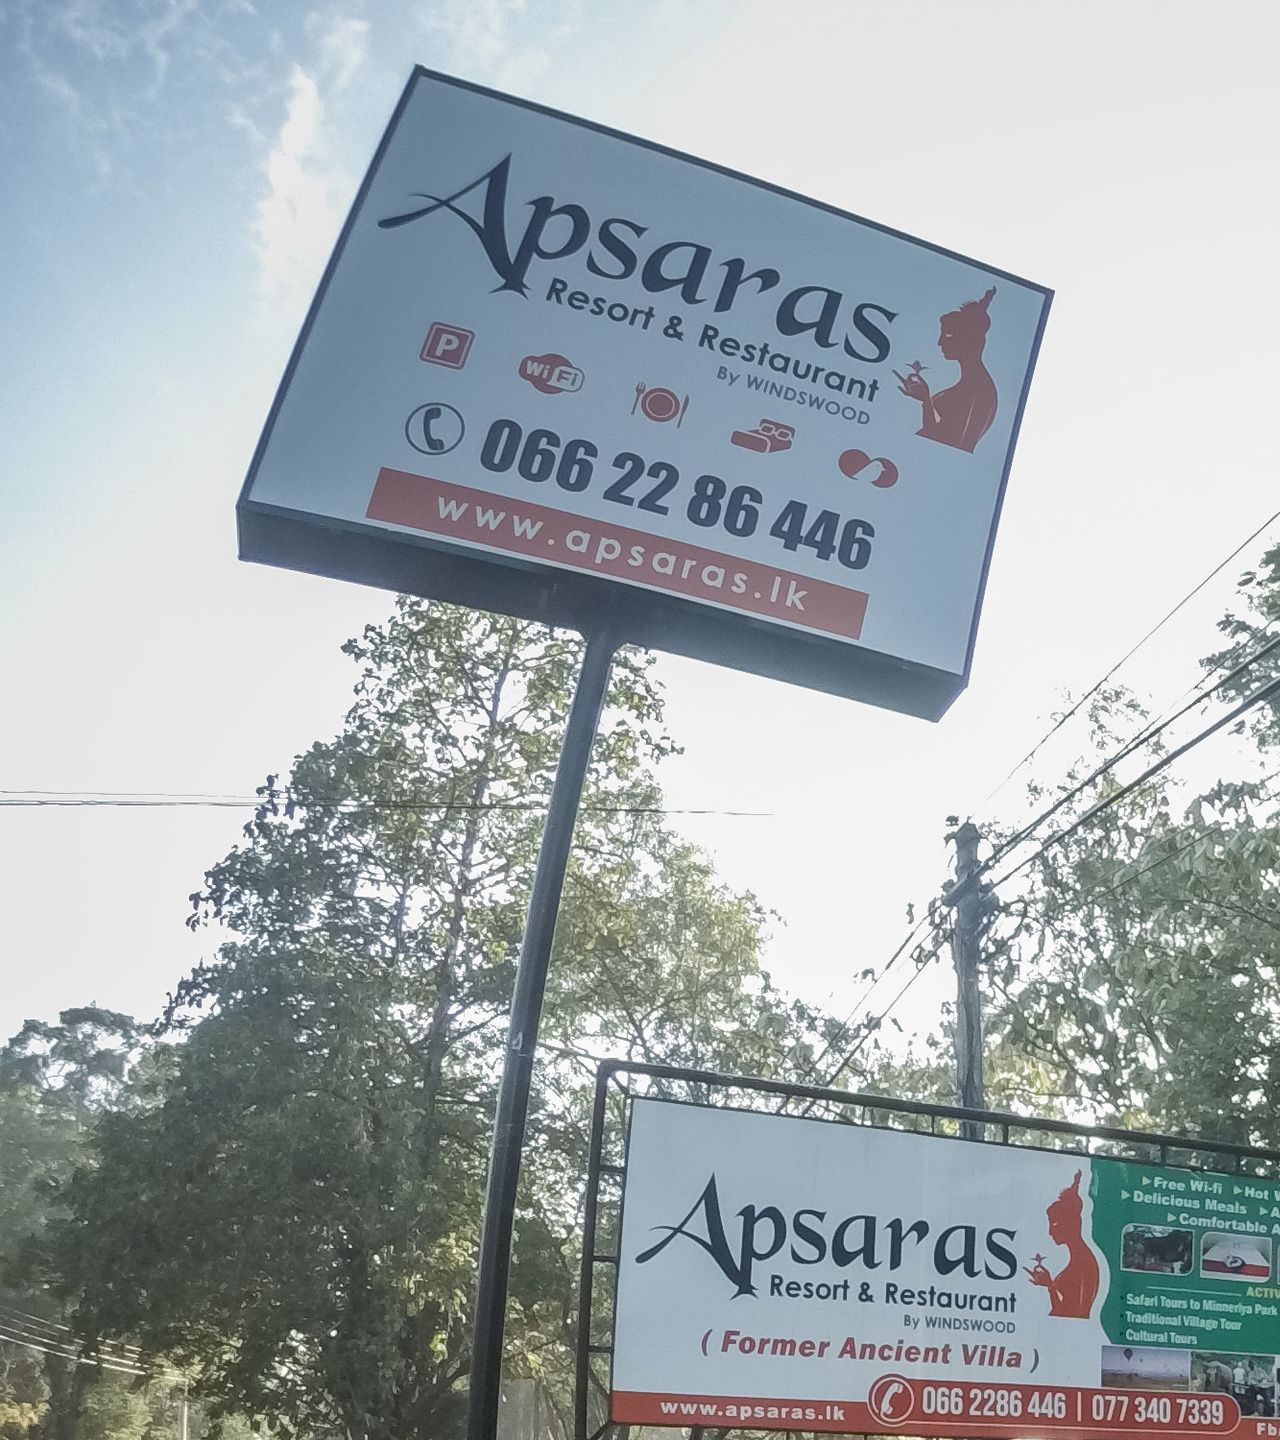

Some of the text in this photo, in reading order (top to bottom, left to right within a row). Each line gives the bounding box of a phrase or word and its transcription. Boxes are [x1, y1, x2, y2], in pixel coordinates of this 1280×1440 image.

[378, 152, 899, 364] Apsaras
[545, 277, 880, 403] Resort & Restaurant
[717, 366, 871, 425] By WINDSWOOD
[480, 419, 875, 570] 066 22 86 446
[438, 496, 808, 611] www.apsaras.lk
[1133, 1190, 1200, 1209] Delicious
[1205, 1199, 1247, 1214] Meals
[1154, 1176, 1186, 1191] Free
[1190, 1179, 1222, 1194] Wi-fi
[1245, 1186, 1270, 1200] Hot
[635, 1172, 1018, 1300] Apsaras
[1179, 1213, 1268, 1233] Comfortable
[770, 1275, 1017, 1313] Resort & Restaurant
[1126, 1293, 1158, 1307] Safari
[1160, 1296, 1188, 1310] Tours
[1190, 1298, 1200, 1310] to
[1255, 1304, 1278, 1316] Park
[904, 1315, 1015, 1333] By WINDSWOOD
[1125, 1311, 1242, 1330] Traditional Village Tour
[1125, 1329, 1198, 1345] Cultural Tours
[721, 1330, 830, 1358] Former
[838, 1337, 951, 1364] Ancient
[961, 1344, 1022, 1368] Villa
[661, 1402, 845, 1422] www.apsaras.lk
[922, 1386, 1223, 1425] 066 2286 446 077 340 7339
